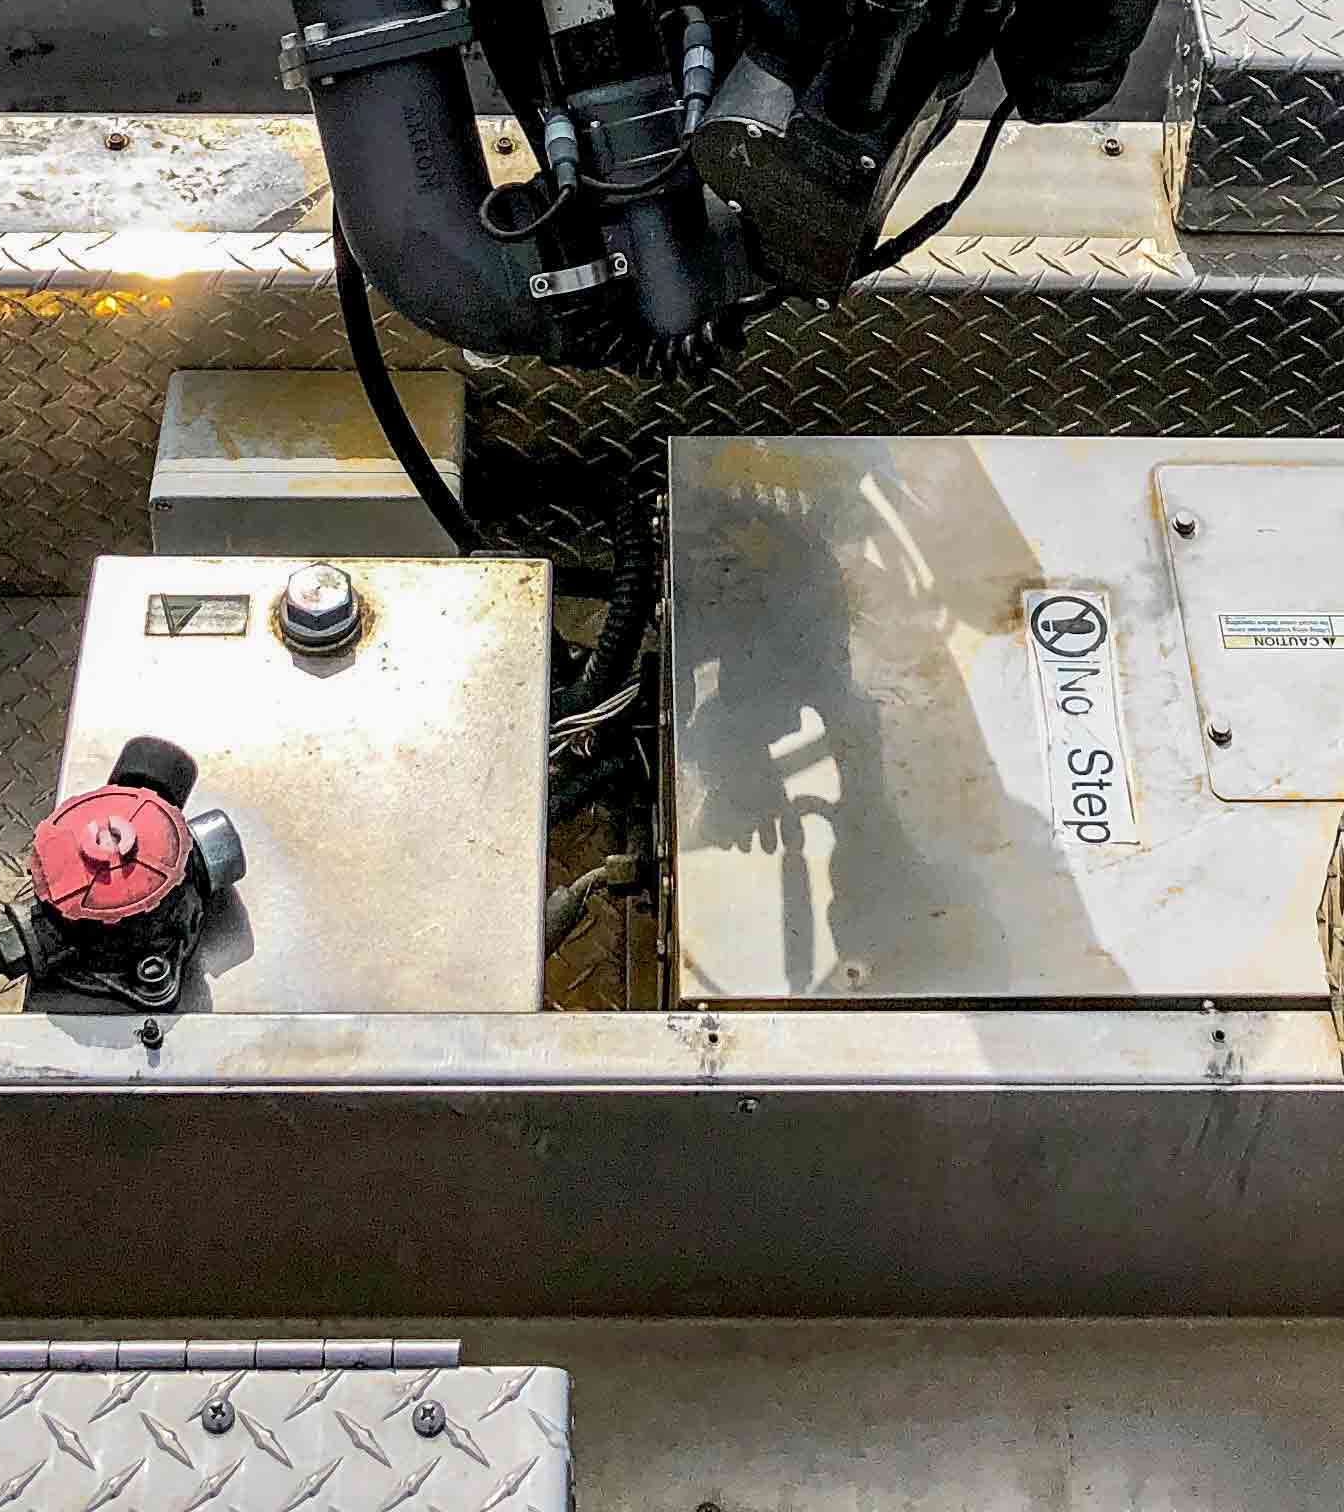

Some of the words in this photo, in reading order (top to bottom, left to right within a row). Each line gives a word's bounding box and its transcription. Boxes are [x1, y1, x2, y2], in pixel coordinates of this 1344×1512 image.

[1254, 636, 1320, 646] CAUTION
[1057, 667, 1100, 716] No
[1063, 748, 1114, 845] Step
